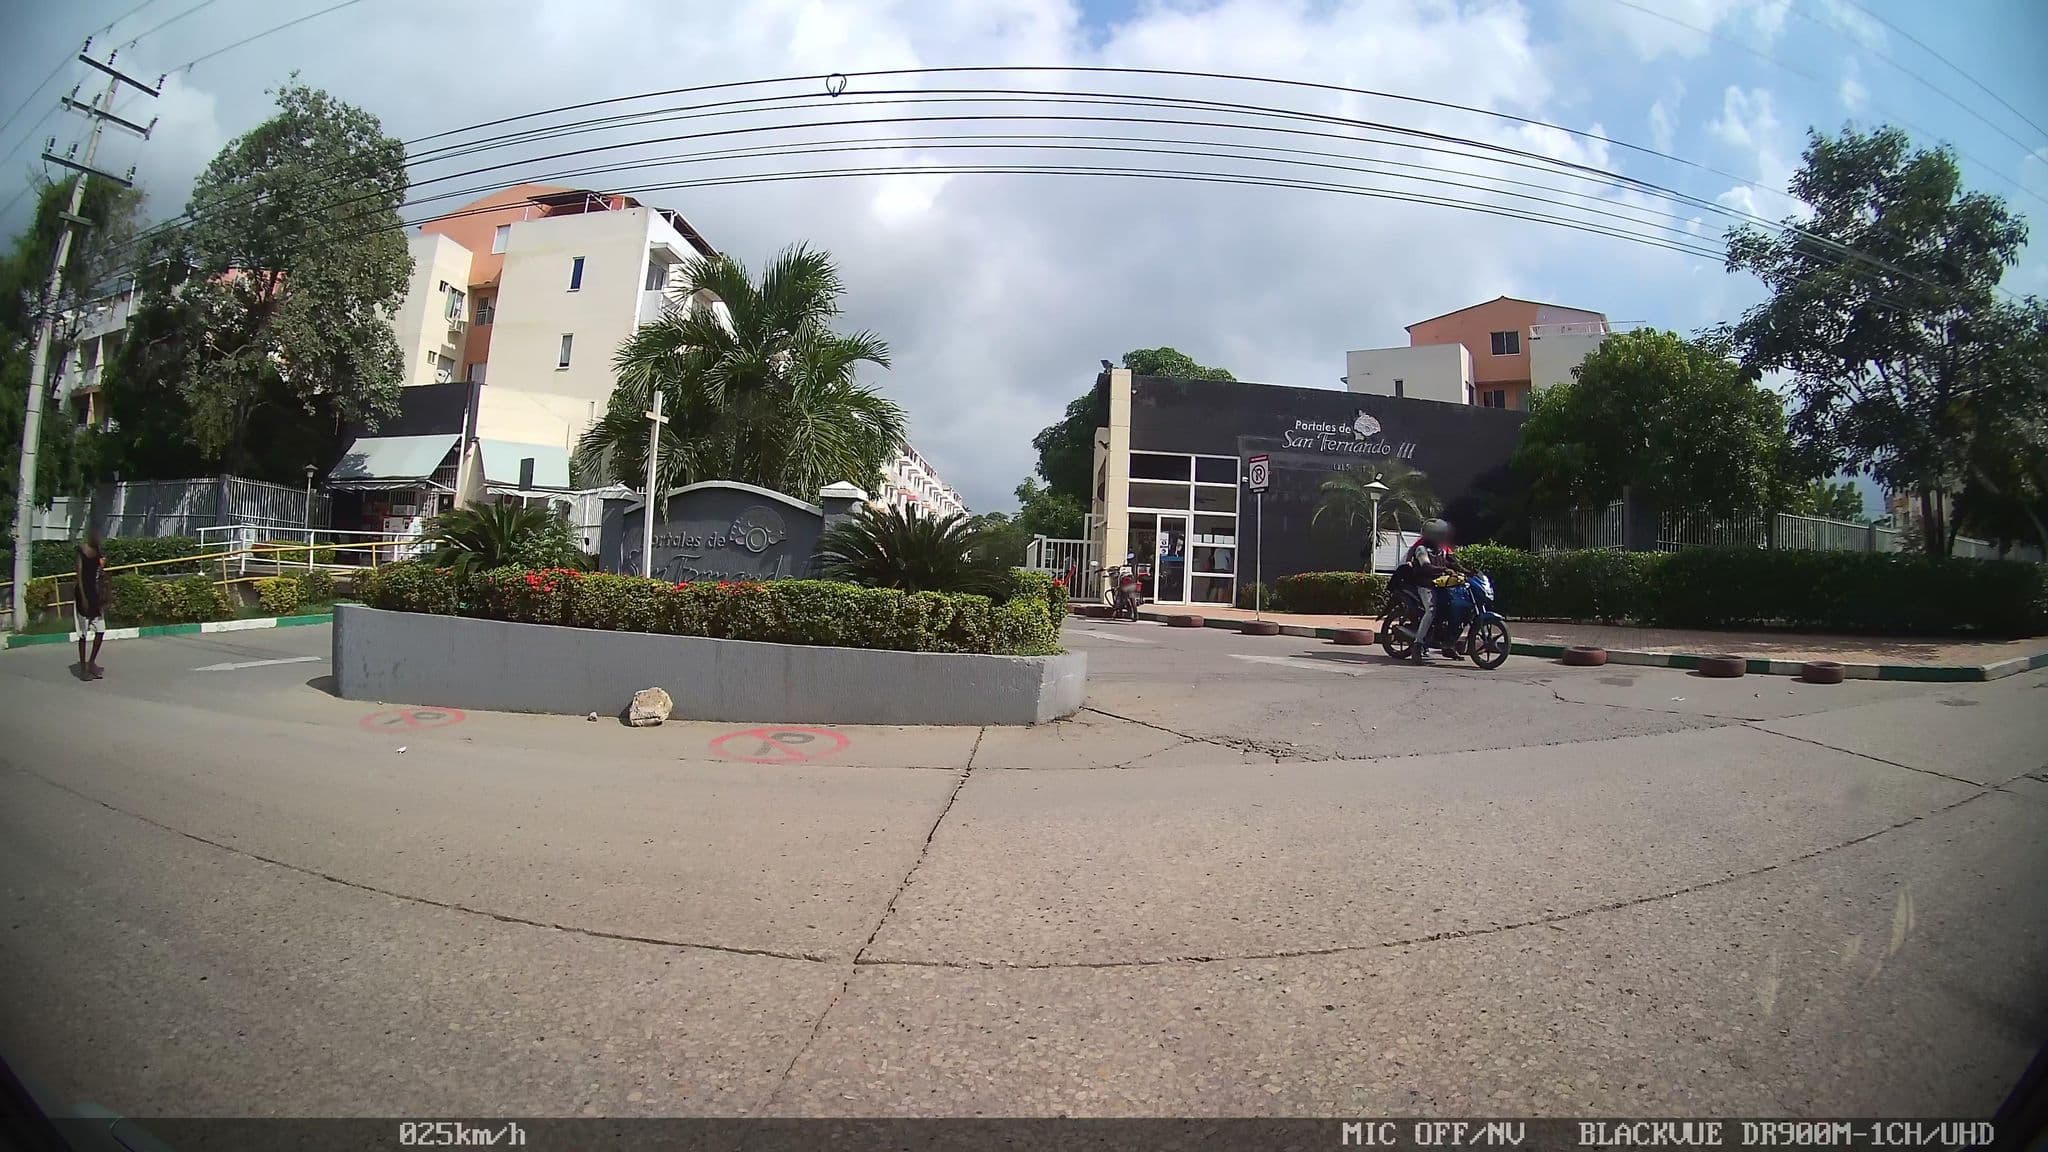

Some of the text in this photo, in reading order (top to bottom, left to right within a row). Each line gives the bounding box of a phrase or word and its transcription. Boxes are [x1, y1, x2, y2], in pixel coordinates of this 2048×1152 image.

[1295, 420, 1351, 434] Portales de
[1282, 429, 1417, 459] San Fernando III
[643, 531, 726, 549] ortales de
